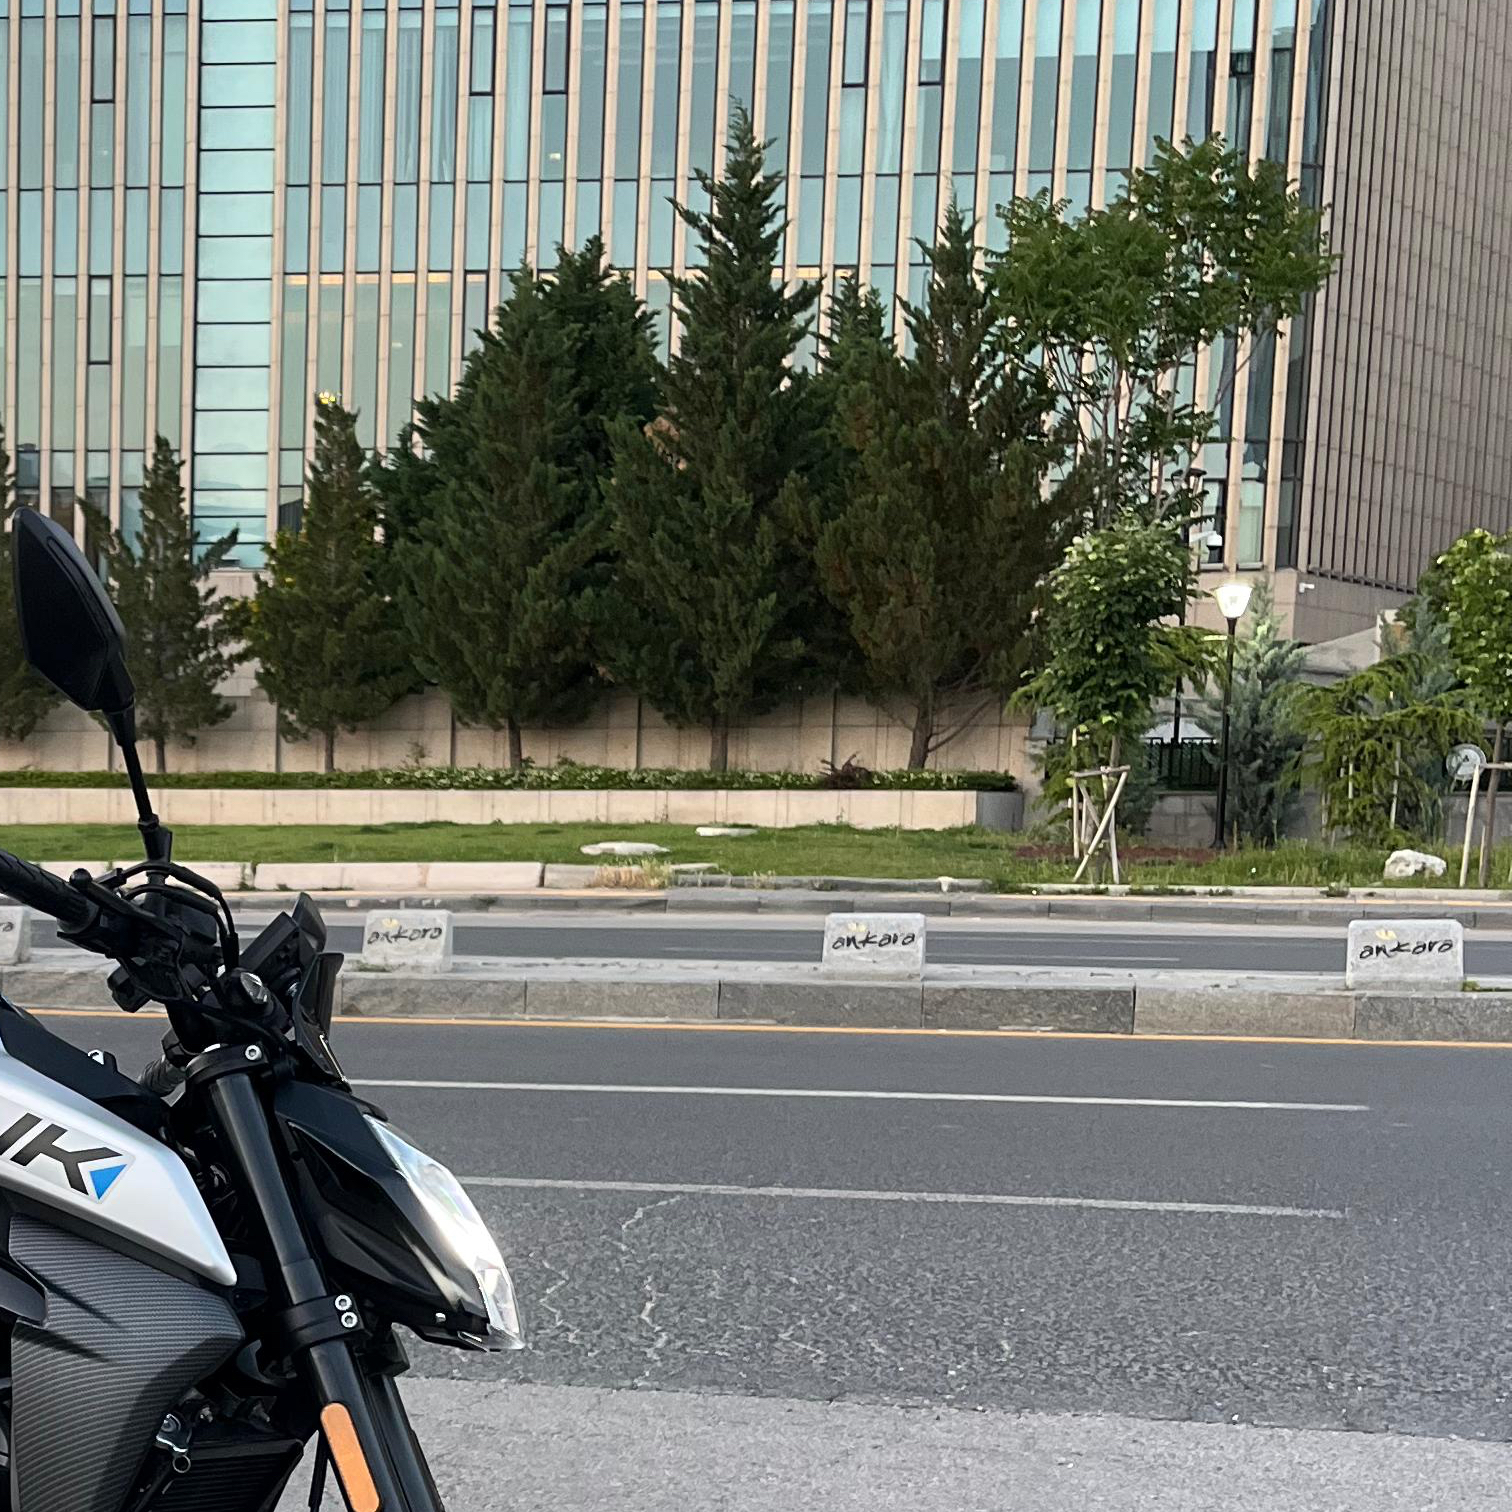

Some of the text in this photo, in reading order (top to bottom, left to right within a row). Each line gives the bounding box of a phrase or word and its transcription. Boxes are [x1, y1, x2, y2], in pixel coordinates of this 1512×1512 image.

[367, 924, 442, 945] ankara
[831, 931, 916, 950] ankara
[1359, 938, 1454, 959] ankara
